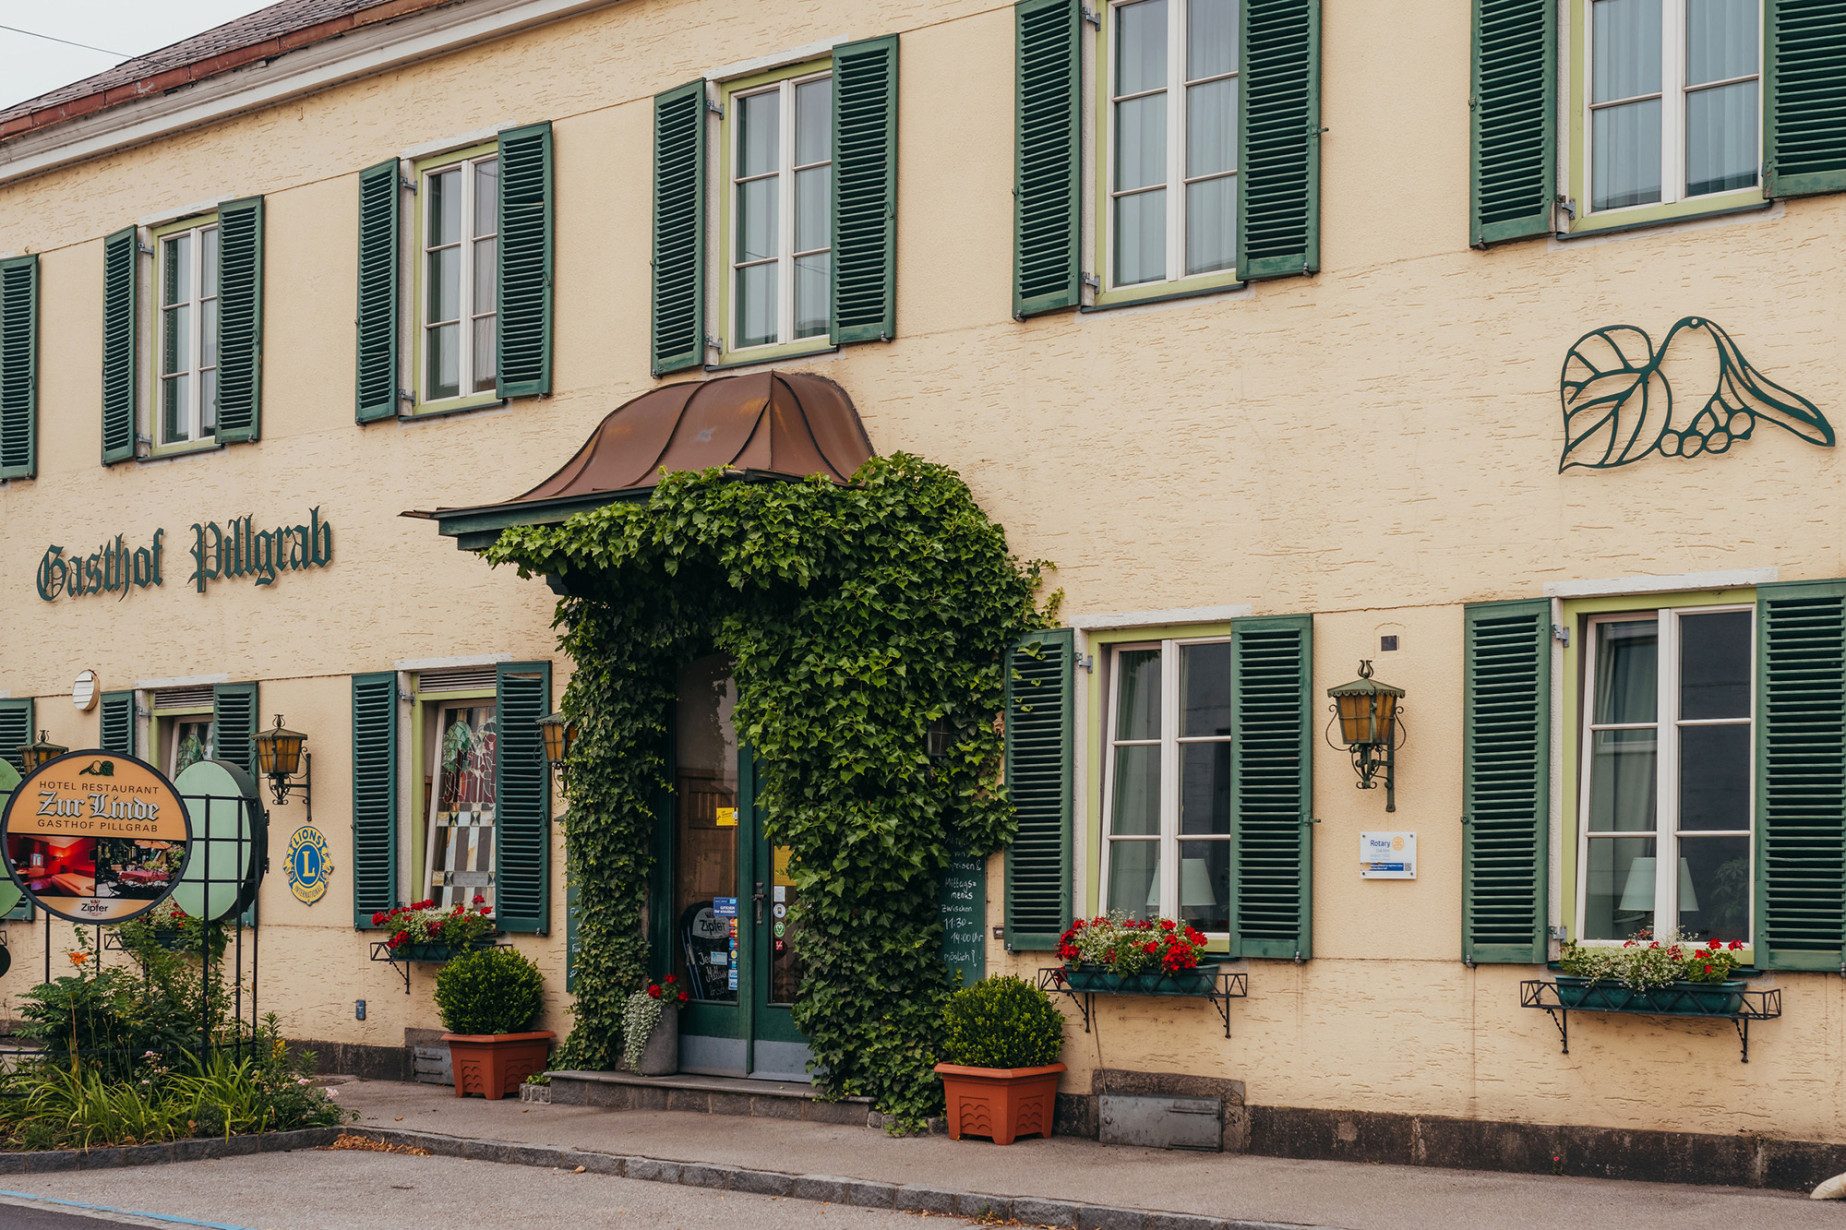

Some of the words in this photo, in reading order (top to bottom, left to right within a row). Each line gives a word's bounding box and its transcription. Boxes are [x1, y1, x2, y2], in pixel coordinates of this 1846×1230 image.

[36, 527, 165, 603] Gasthof
[188, 505, 333, 594] Pillgrab
[39, 781, 76, 791] HOTEL
[81, 783, 159, 794] RESTAURANT
[36, 790, 86, 817] Zur
[88, 792, 161, 821] Linde
[37, 819, 95, 830] GASTHOF
[100, 821, 159, 833] PILLGRAB
[294, 829, 321, 846] LIONS
[1370, 839, 1390, 849] Rotary
[303, 851, 316, 876] L
[81, 903, 109, 913] Zipfer
